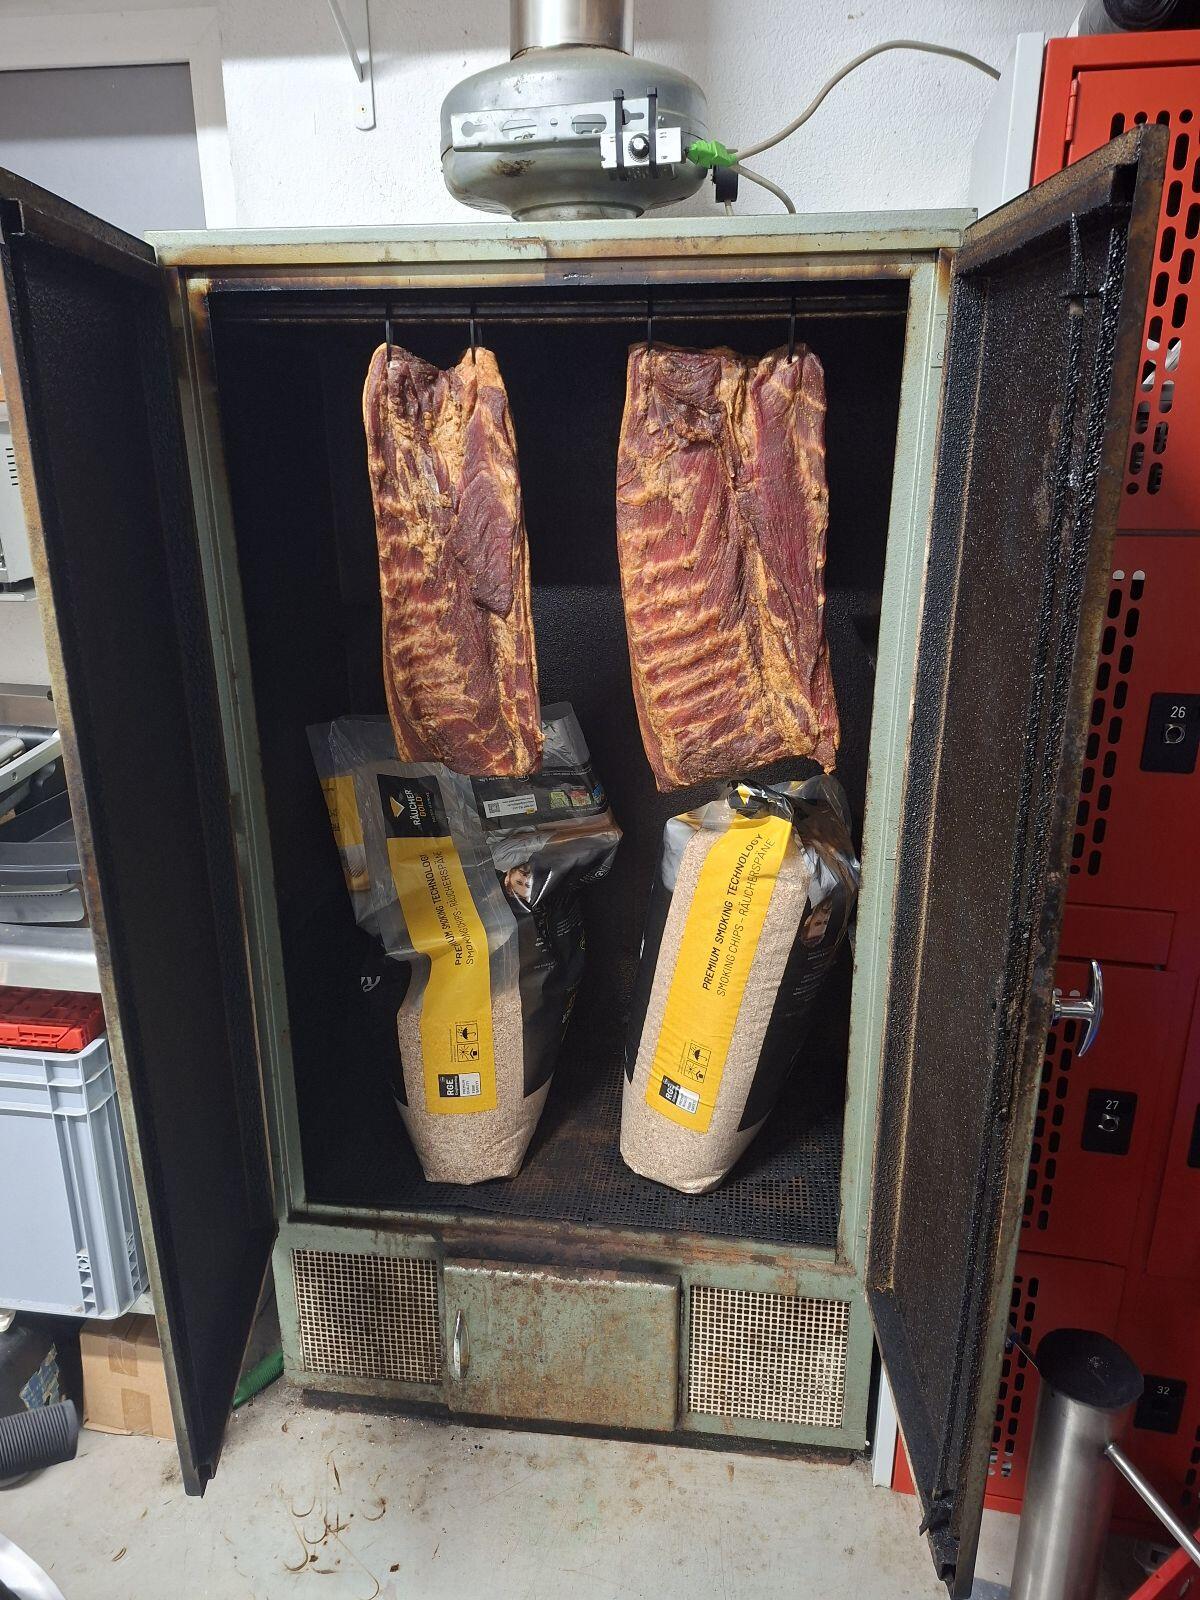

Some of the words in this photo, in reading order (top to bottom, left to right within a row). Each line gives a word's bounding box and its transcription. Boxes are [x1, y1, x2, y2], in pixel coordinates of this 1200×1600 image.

[1170, 705, 1186, 718] 26
[404, 789, 421, 826] RÄUCHER
[415, 796, 427, 817] GOLD
[435, 905, 451, 930] SMOKING
[453, 910, 467, 929] CHIPS
[702, 946, 721, 991] PREMIUM
[714, 900, 733, 944] SMOKING
[726, 833, 764, 896] TECHNOLOGY
[716, 954, 736, 997] SMOKING
[728, 923, 744, 954] CHIPS
[738, 838, 776, 917] RÄUCHERSPÄNE
[444, 930, 463, 966] PREMIUM
[458, 928, 475, 965] SMOKING
[446, 1078, 455, 1096] RGE
[1105, 1099, 1119, 1110] 27
[1157, 1385, 1170, 1395] 32
